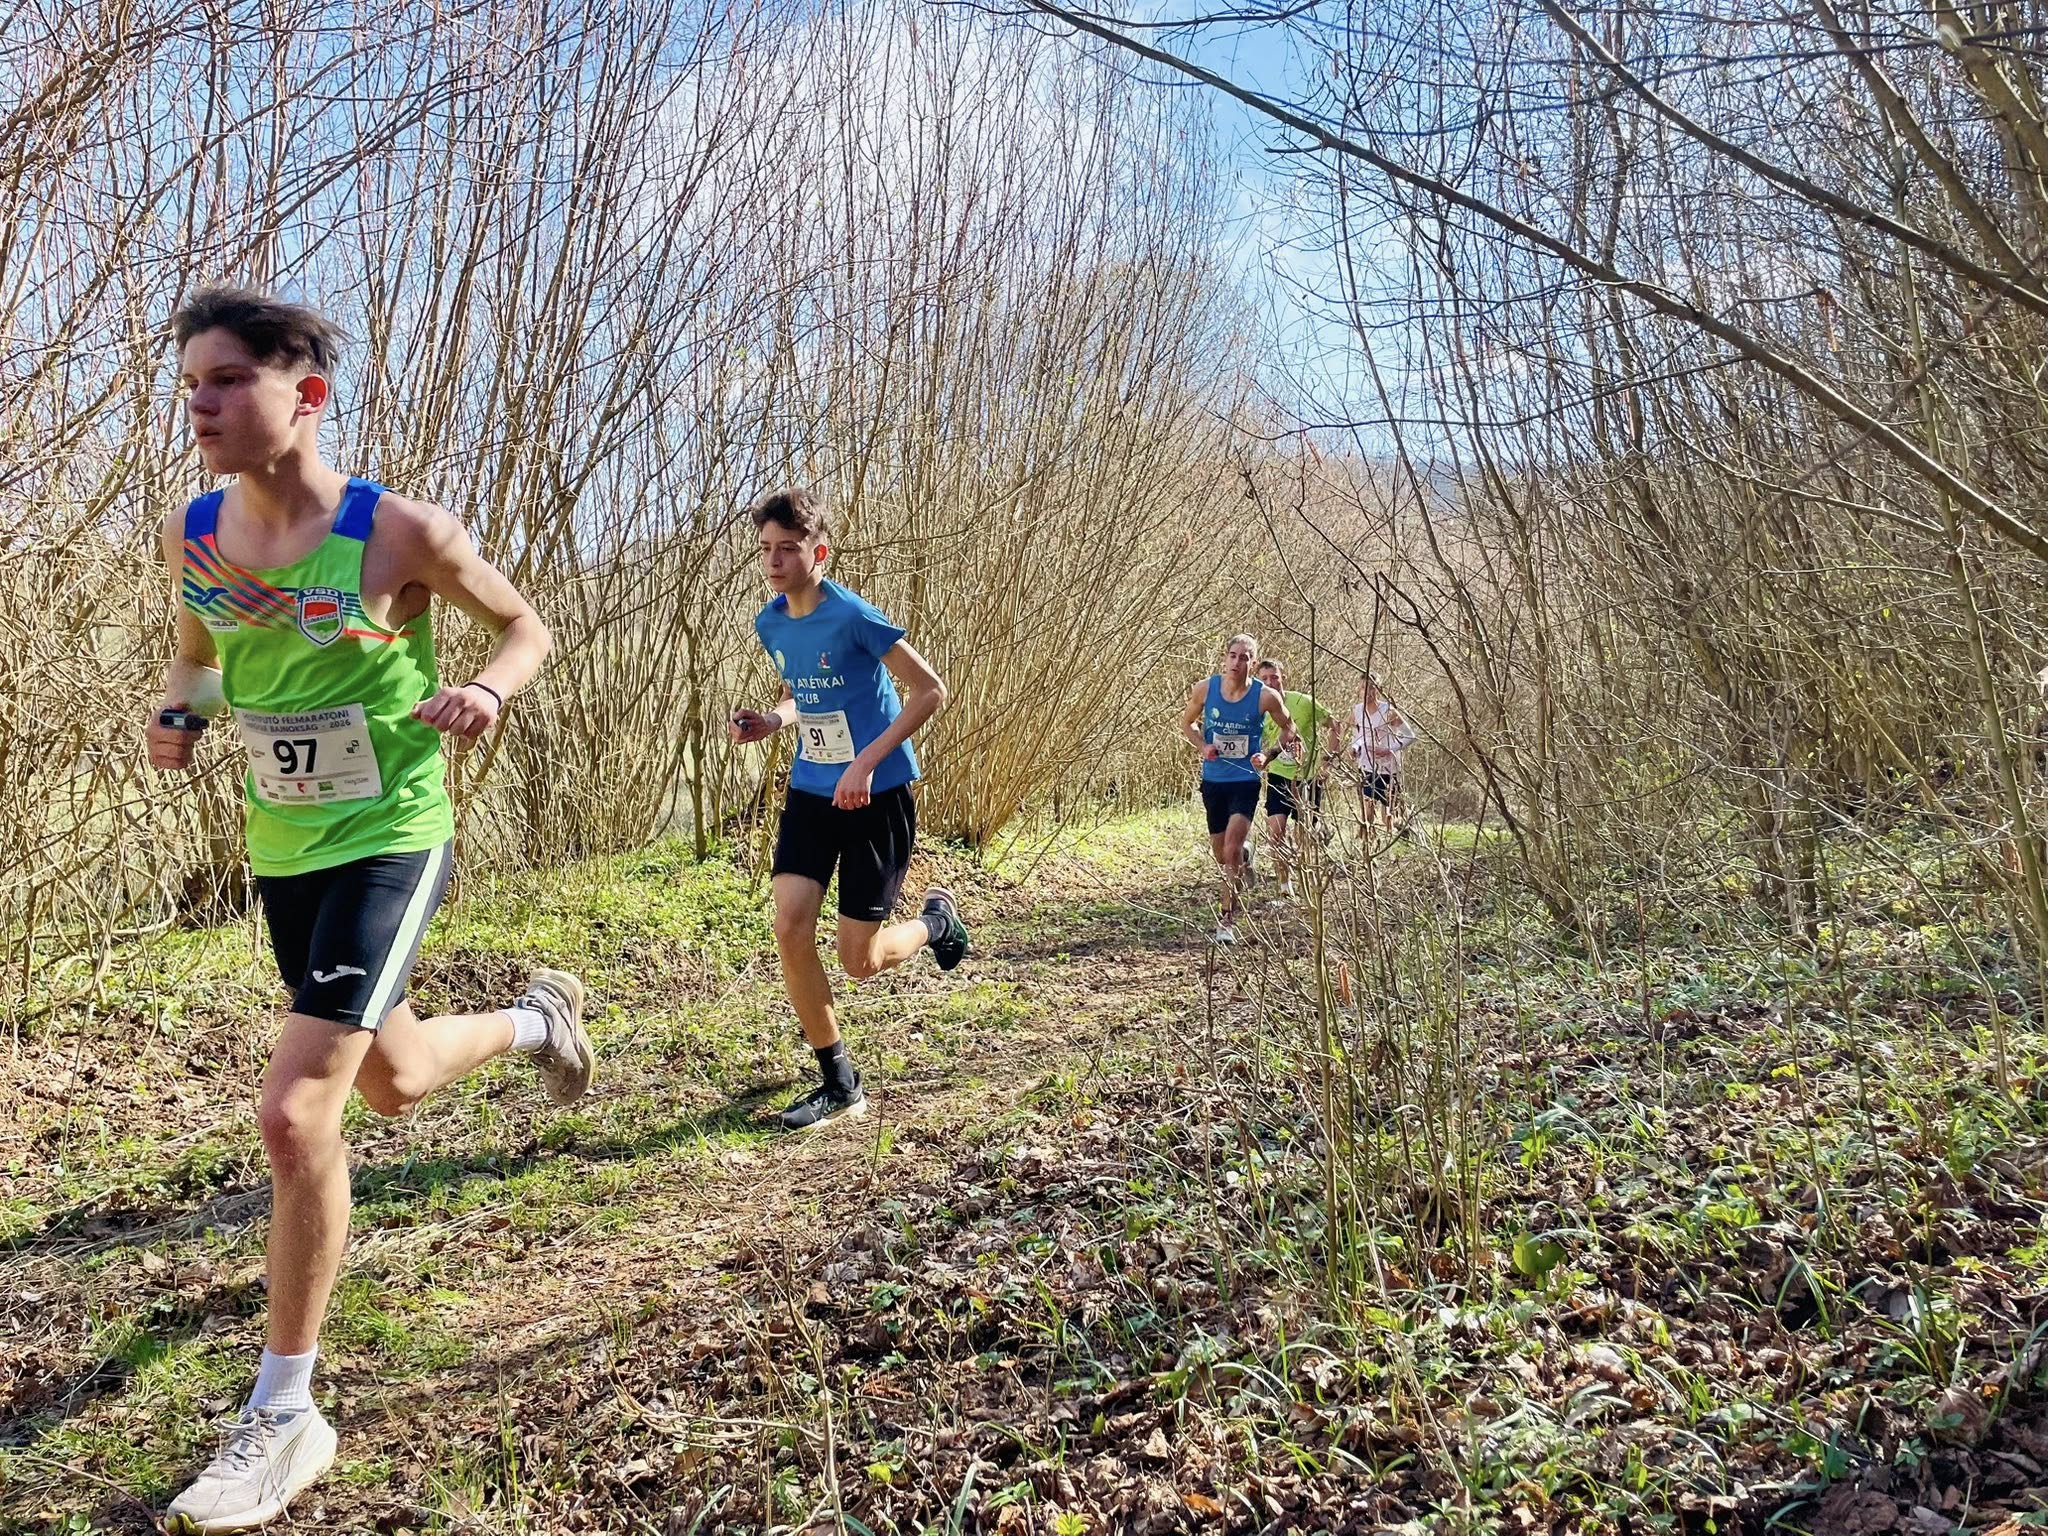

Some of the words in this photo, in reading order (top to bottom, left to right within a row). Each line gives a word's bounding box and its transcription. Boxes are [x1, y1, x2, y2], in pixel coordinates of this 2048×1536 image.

[302, 588, 339, 597] VSD
[797, 675, 845, 689] ATLÉTIKAI
[796, 693, 820, 704] CLUB
[329, 719, 351, 729] 2026
[809, 727, 827, 747] 91
[1222, 741, 1236, 751] 70
[272, 738, 317, 774] 97
